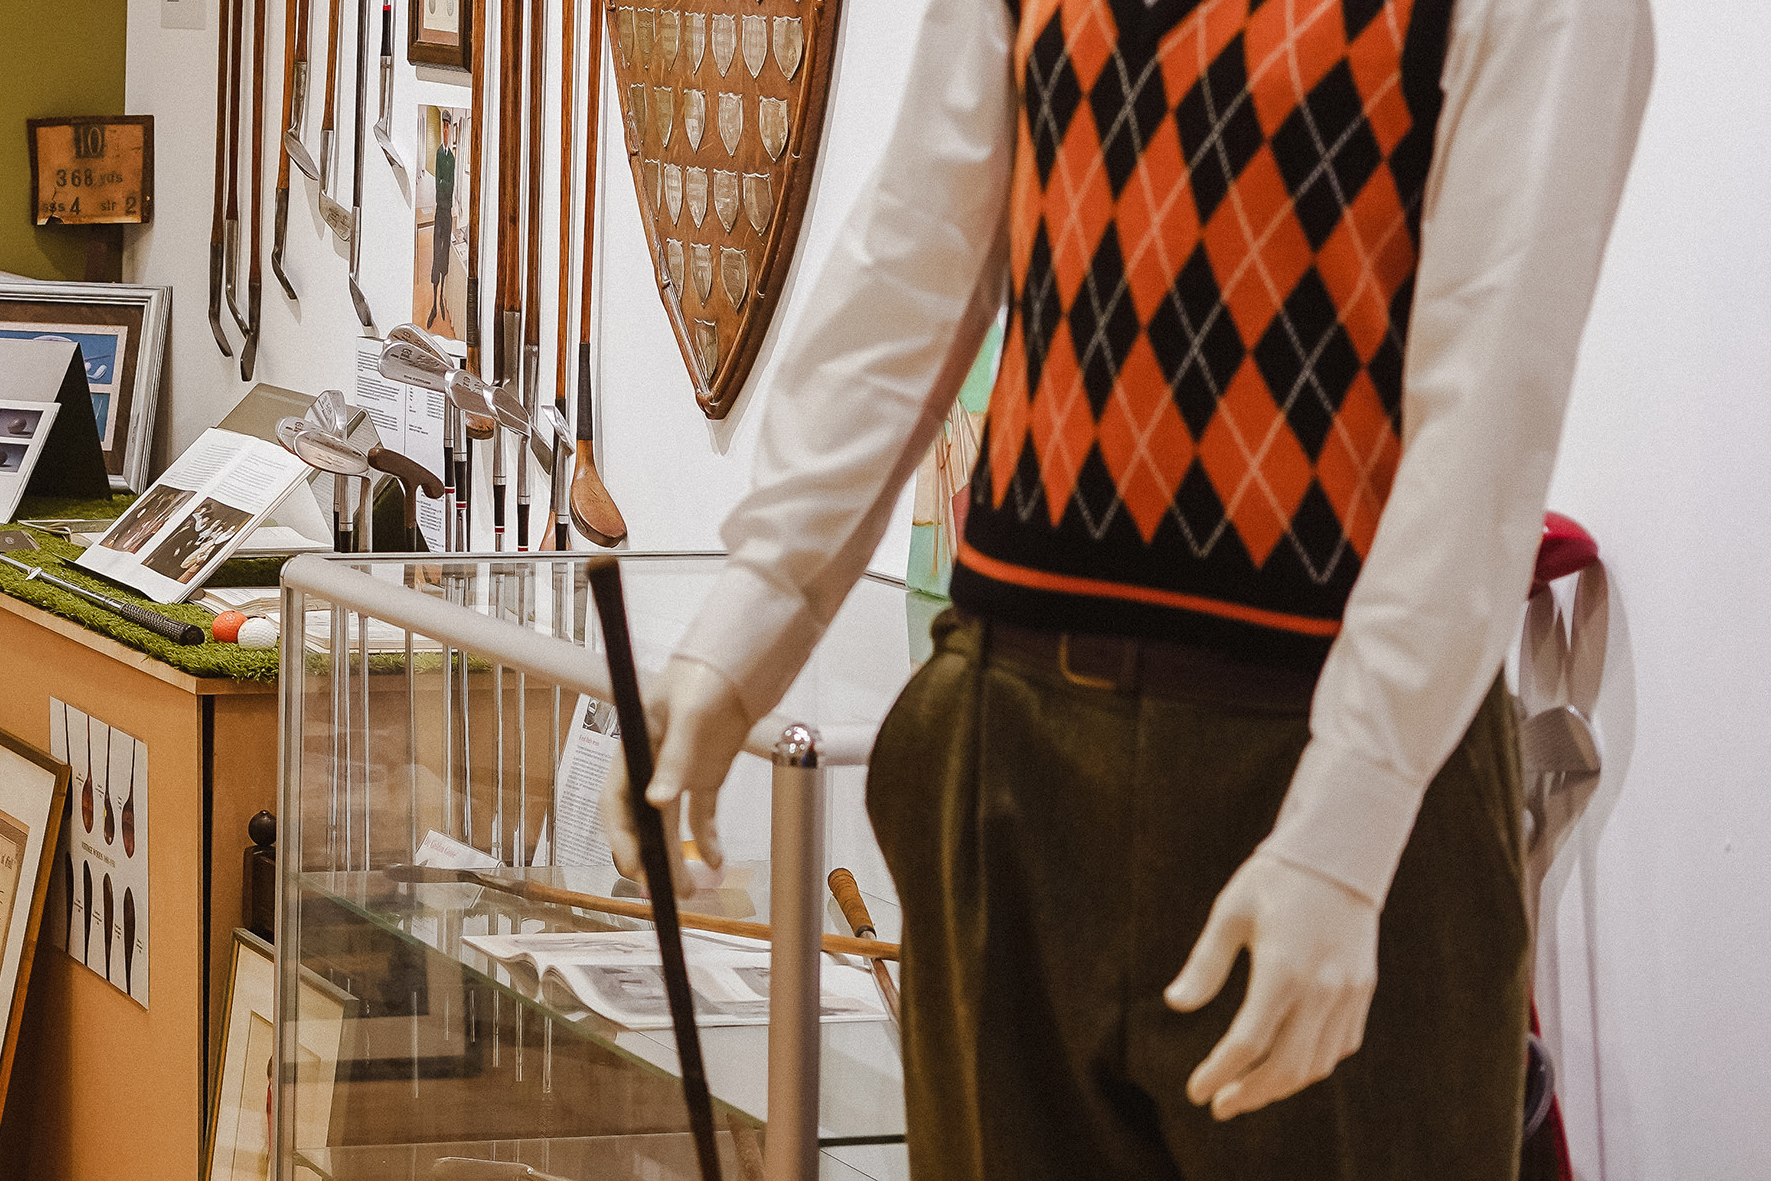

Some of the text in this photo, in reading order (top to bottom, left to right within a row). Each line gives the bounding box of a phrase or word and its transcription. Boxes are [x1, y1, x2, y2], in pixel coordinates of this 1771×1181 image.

[56, 169, 93, 188] 368
[69, 196, 81, 216] 4
[125, 196, 137, 216] 2
